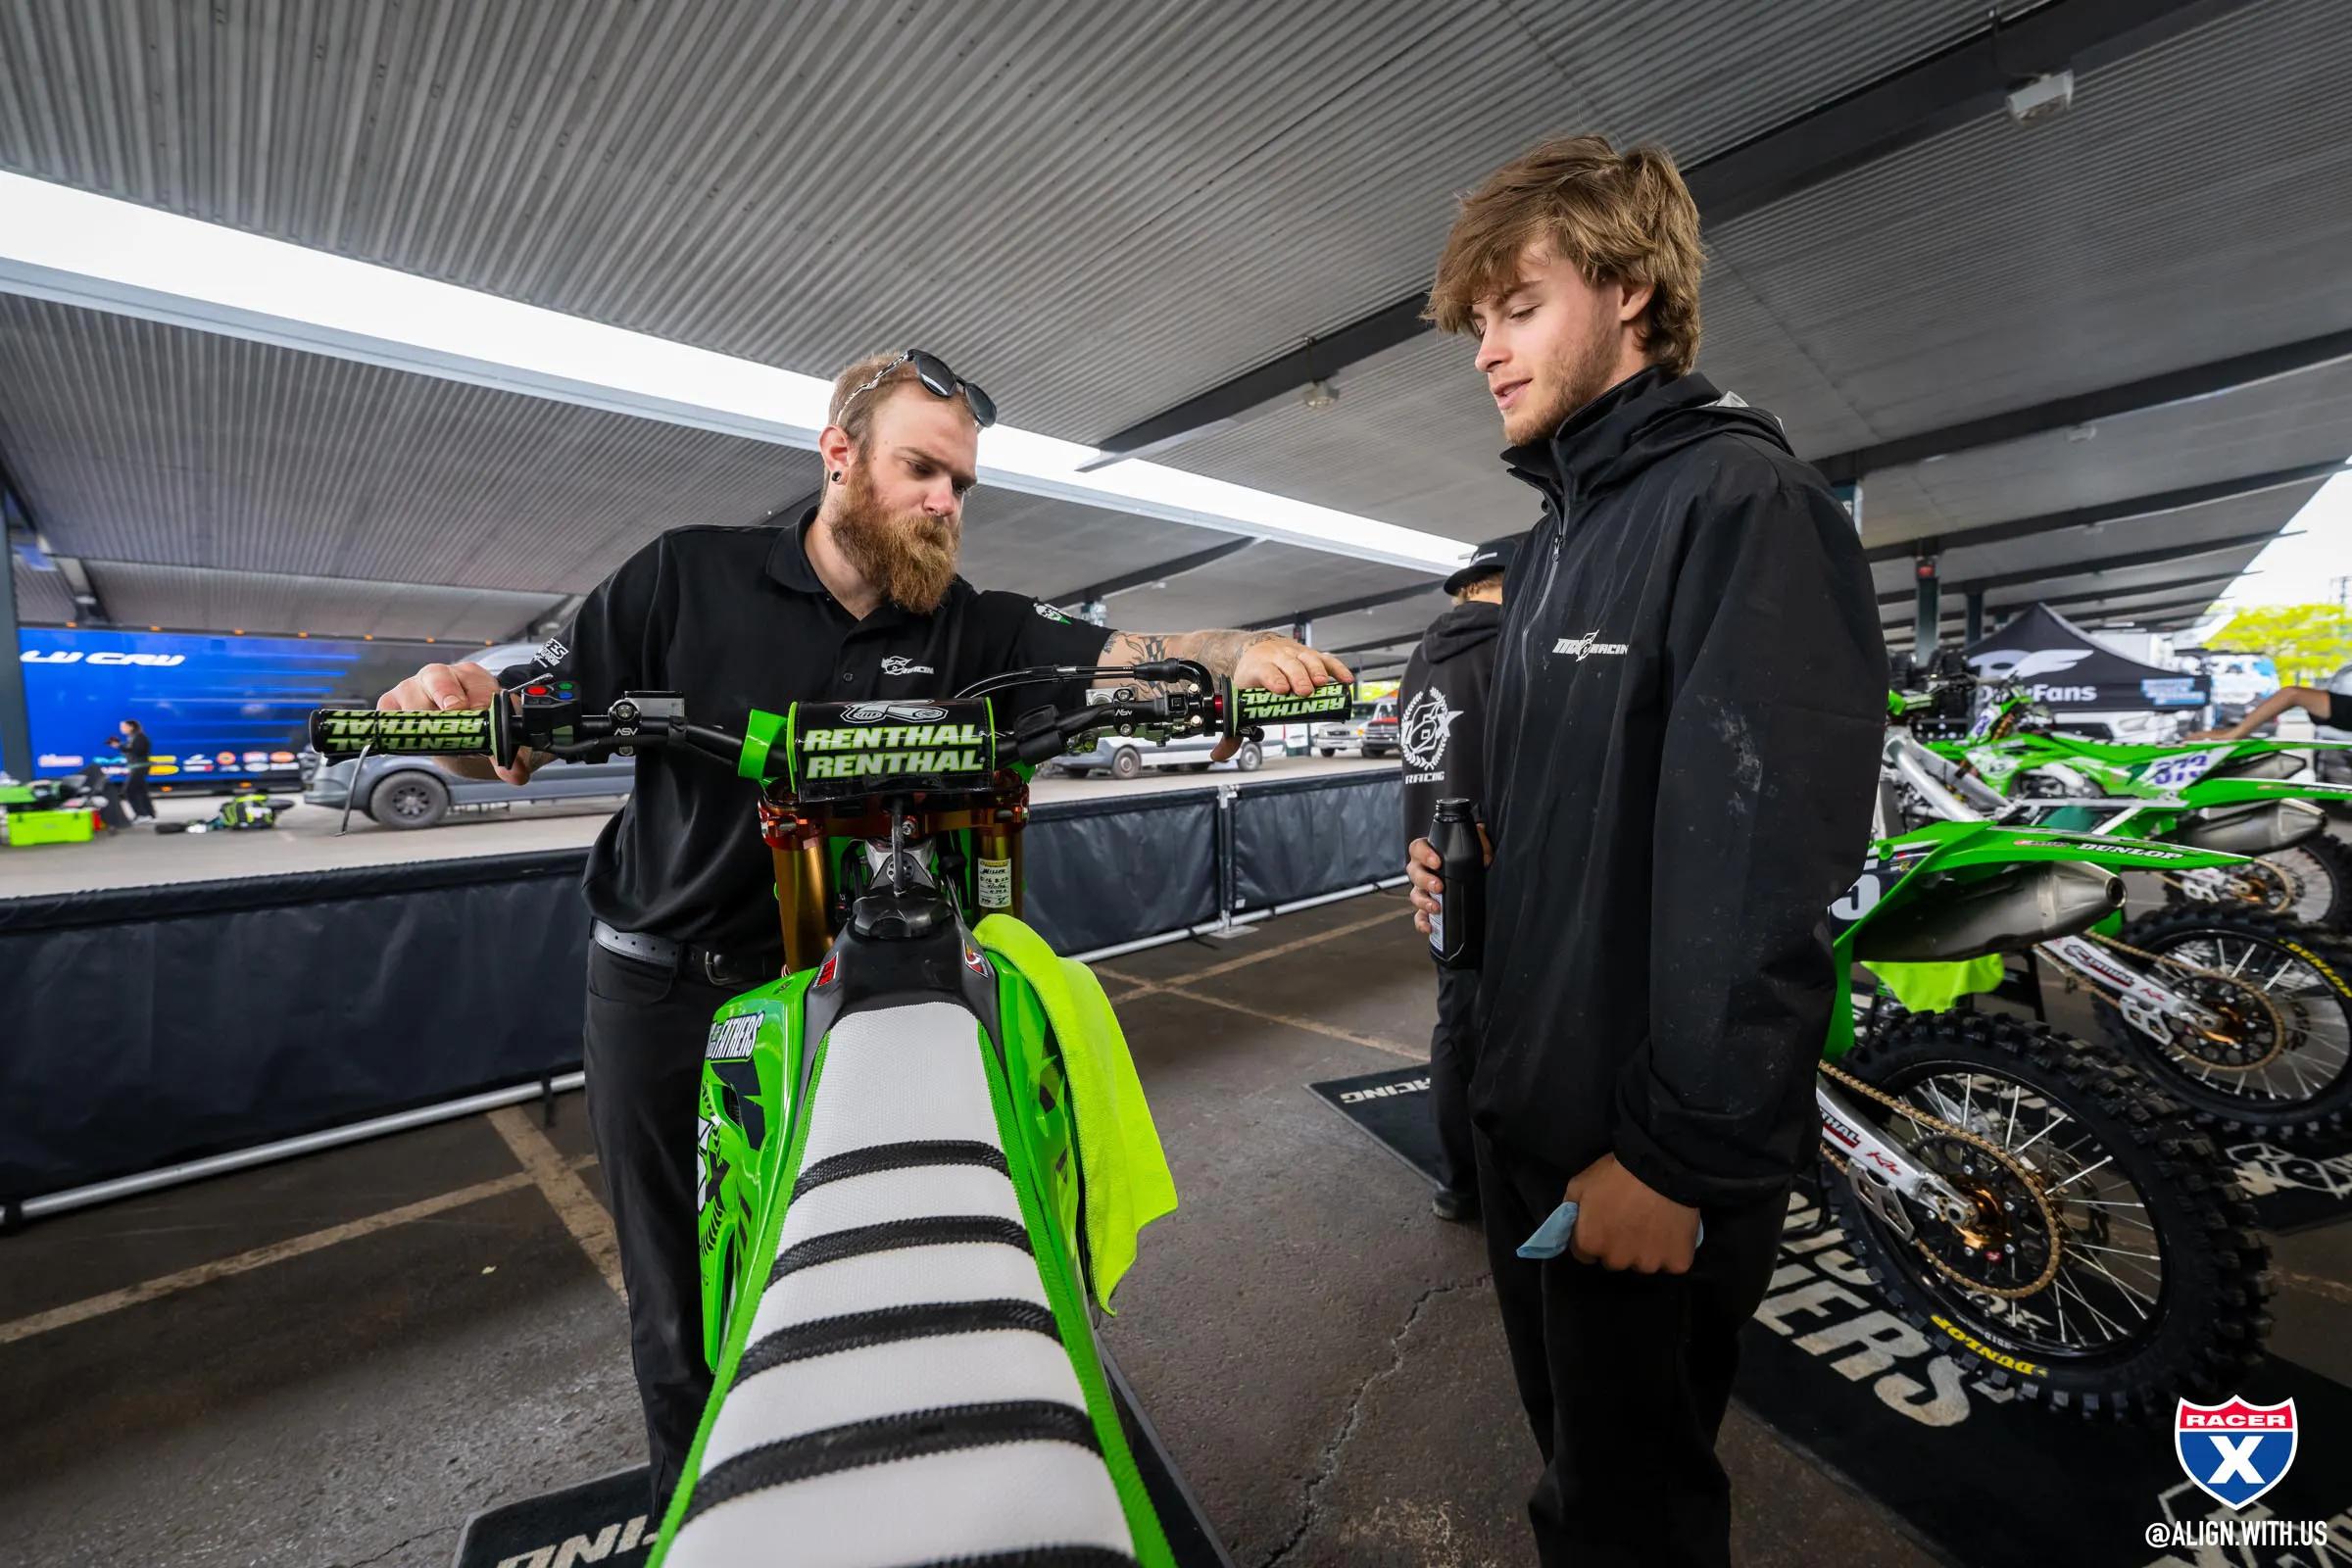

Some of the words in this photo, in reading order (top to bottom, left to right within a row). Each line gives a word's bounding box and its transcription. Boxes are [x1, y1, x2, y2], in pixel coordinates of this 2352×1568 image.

[1244, 696, 1346, 719] RENTHAL
[325, 717, 484, 735] RENTHAL
[613, 727, 639, 736] ASV
[803, 724, 983, 752] RENTHAL
[806, 750, 984, 779] RENTHAL
[2078, 842, 2183, 859] DUNLOP
[1931, 1314, 2038, 1376] DUNLOP
